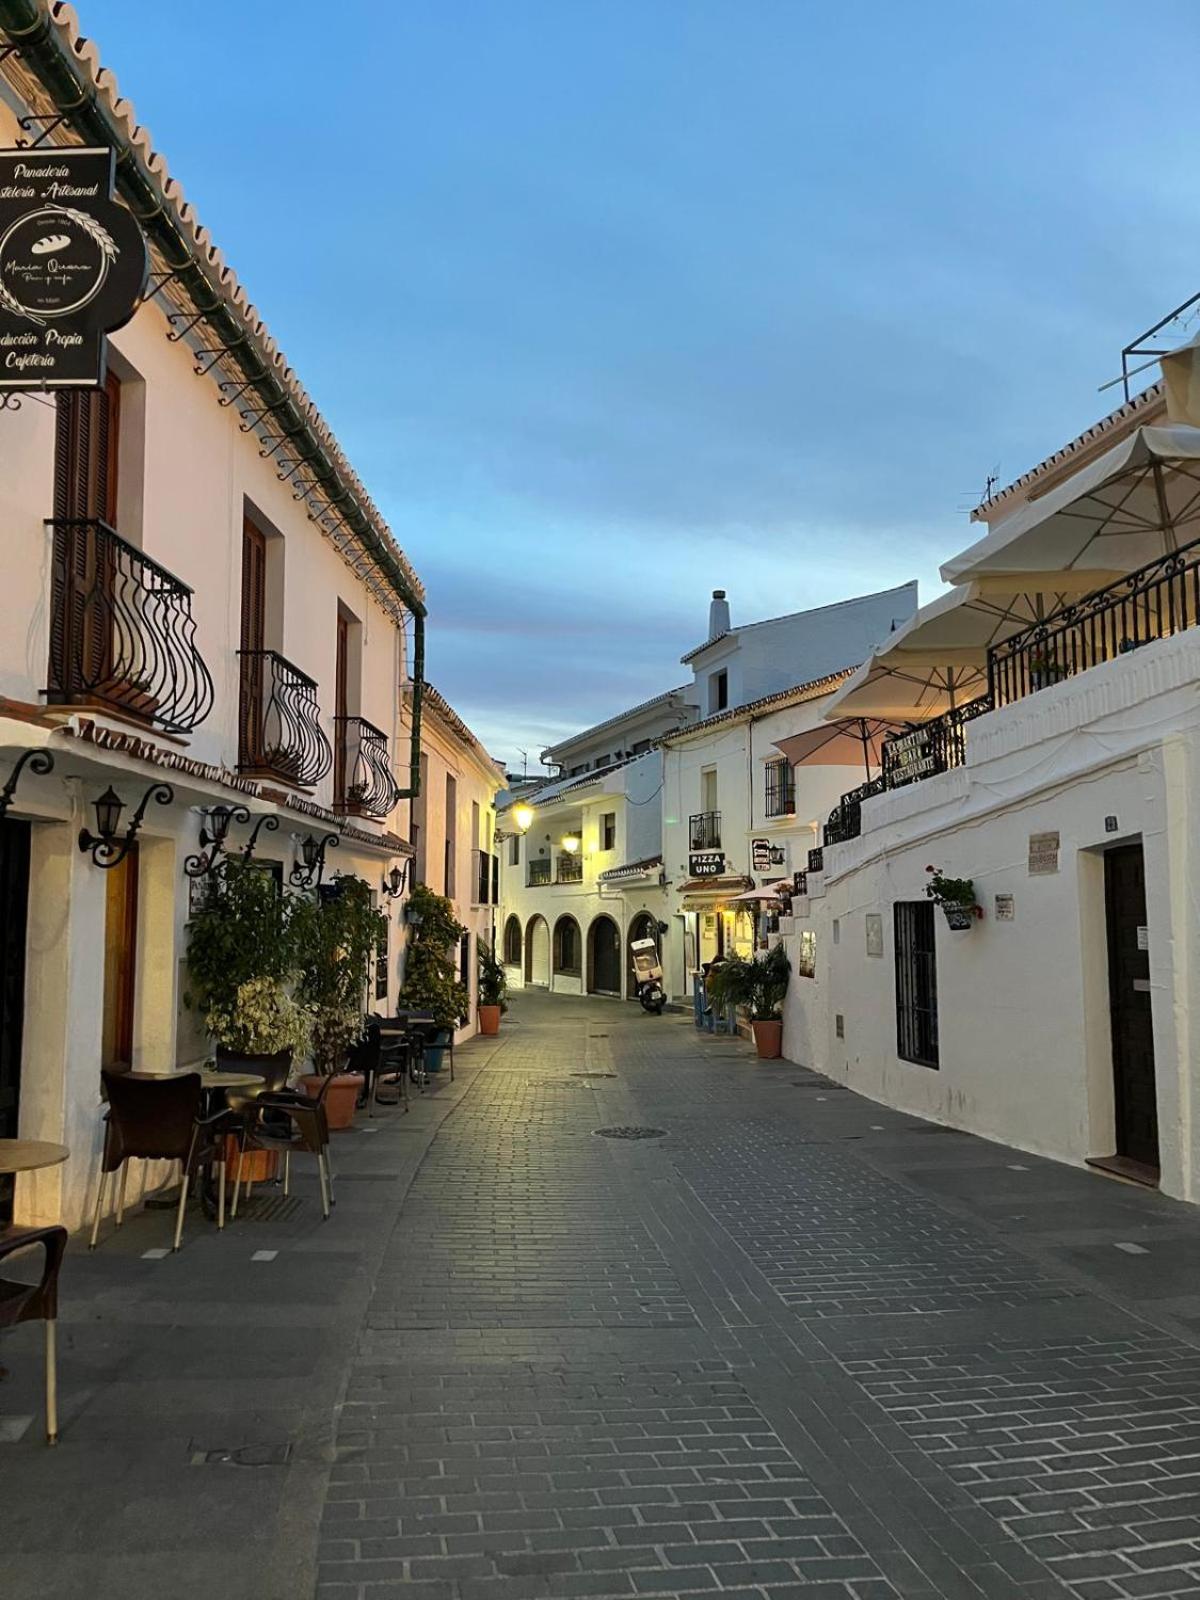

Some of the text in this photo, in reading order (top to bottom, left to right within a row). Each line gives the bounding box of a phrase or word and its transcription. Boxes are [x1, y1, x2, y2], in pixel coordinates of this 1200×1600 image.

[14, 163, 70, 179] Panadería
[41, 181, 99, 199] Artesanal
[44, 328, 84, 349] Propia
[5, 351, 56, 371] Cafetería
[692, 854, 720, 864] PIZZA
[696, 864, 717, 873] UNO
